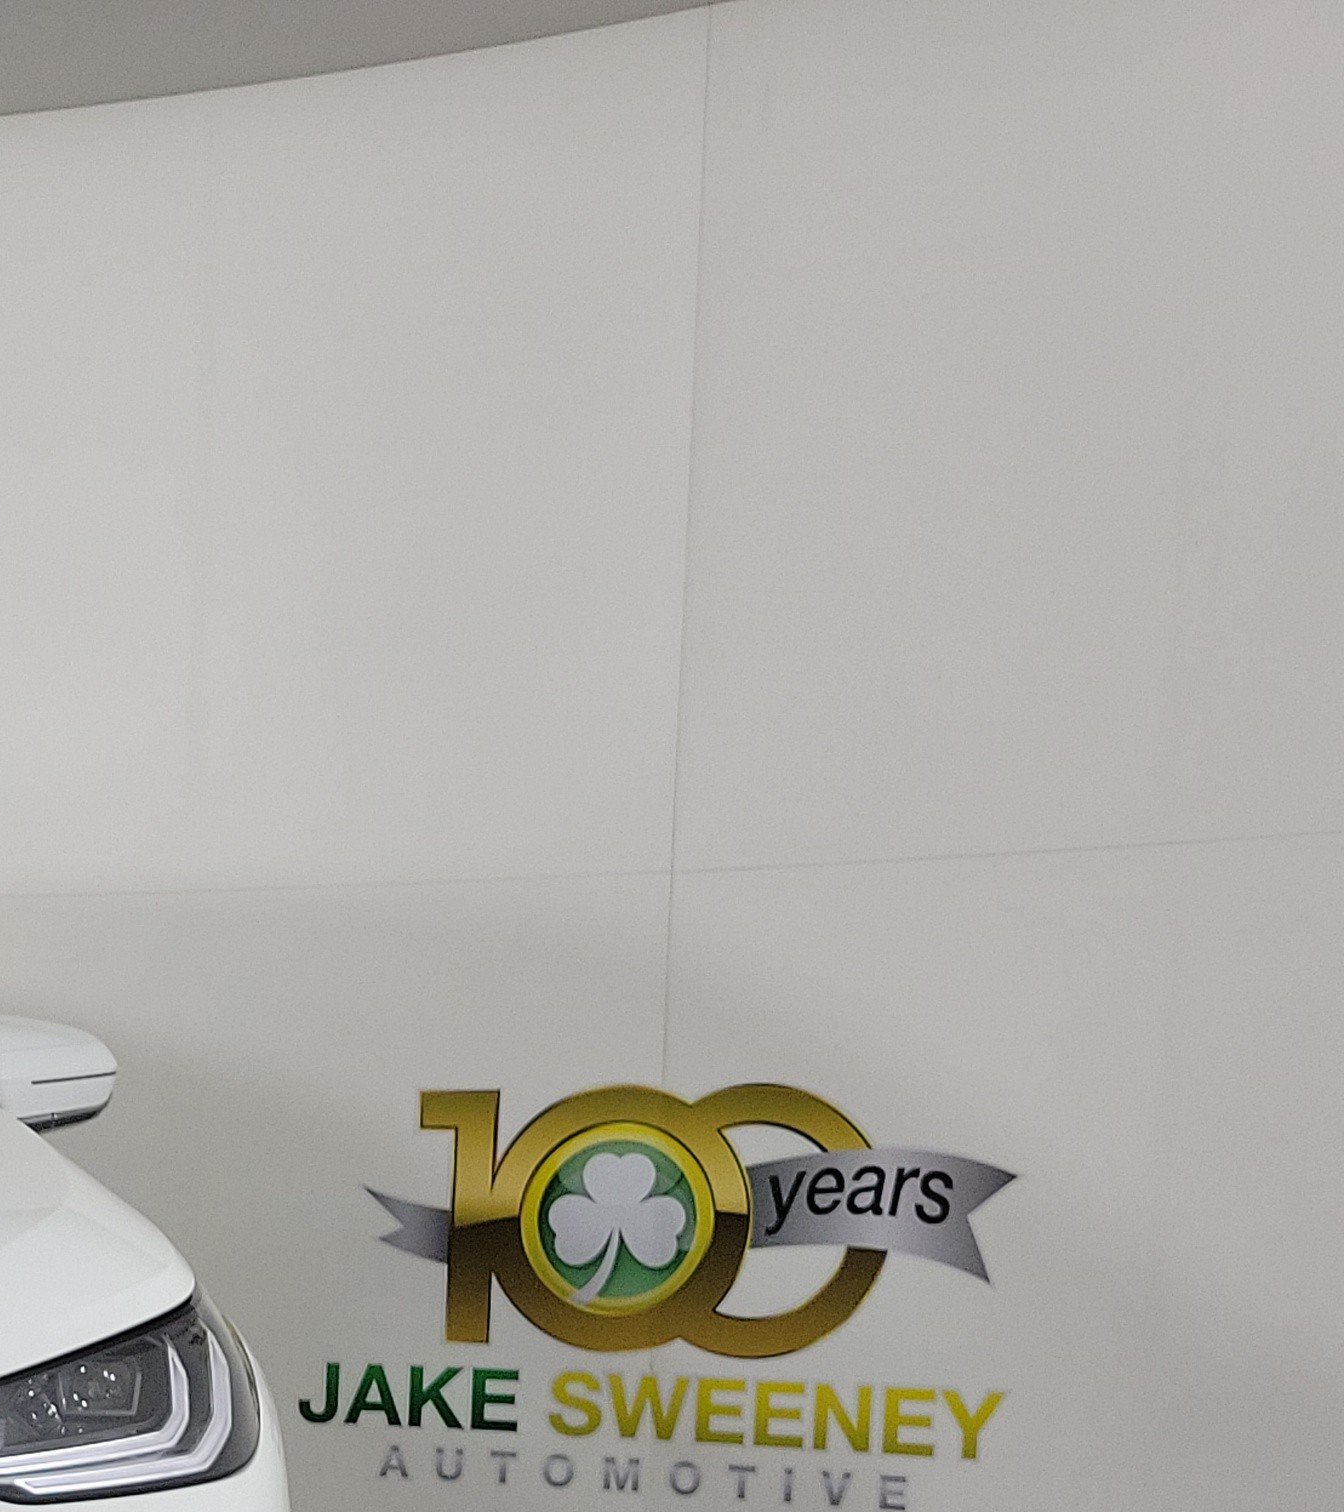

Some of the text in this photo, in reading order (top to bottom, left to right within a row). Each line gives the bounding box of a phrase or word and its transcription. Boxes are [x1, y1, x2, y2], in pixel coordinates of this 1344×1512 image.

[420, 1083, 956, 1359] 100 years
[299, 1363, 1005, 1461] JAKE SWEENEY
[379, 1445, 907, 1512] AUTOMOTIVE
